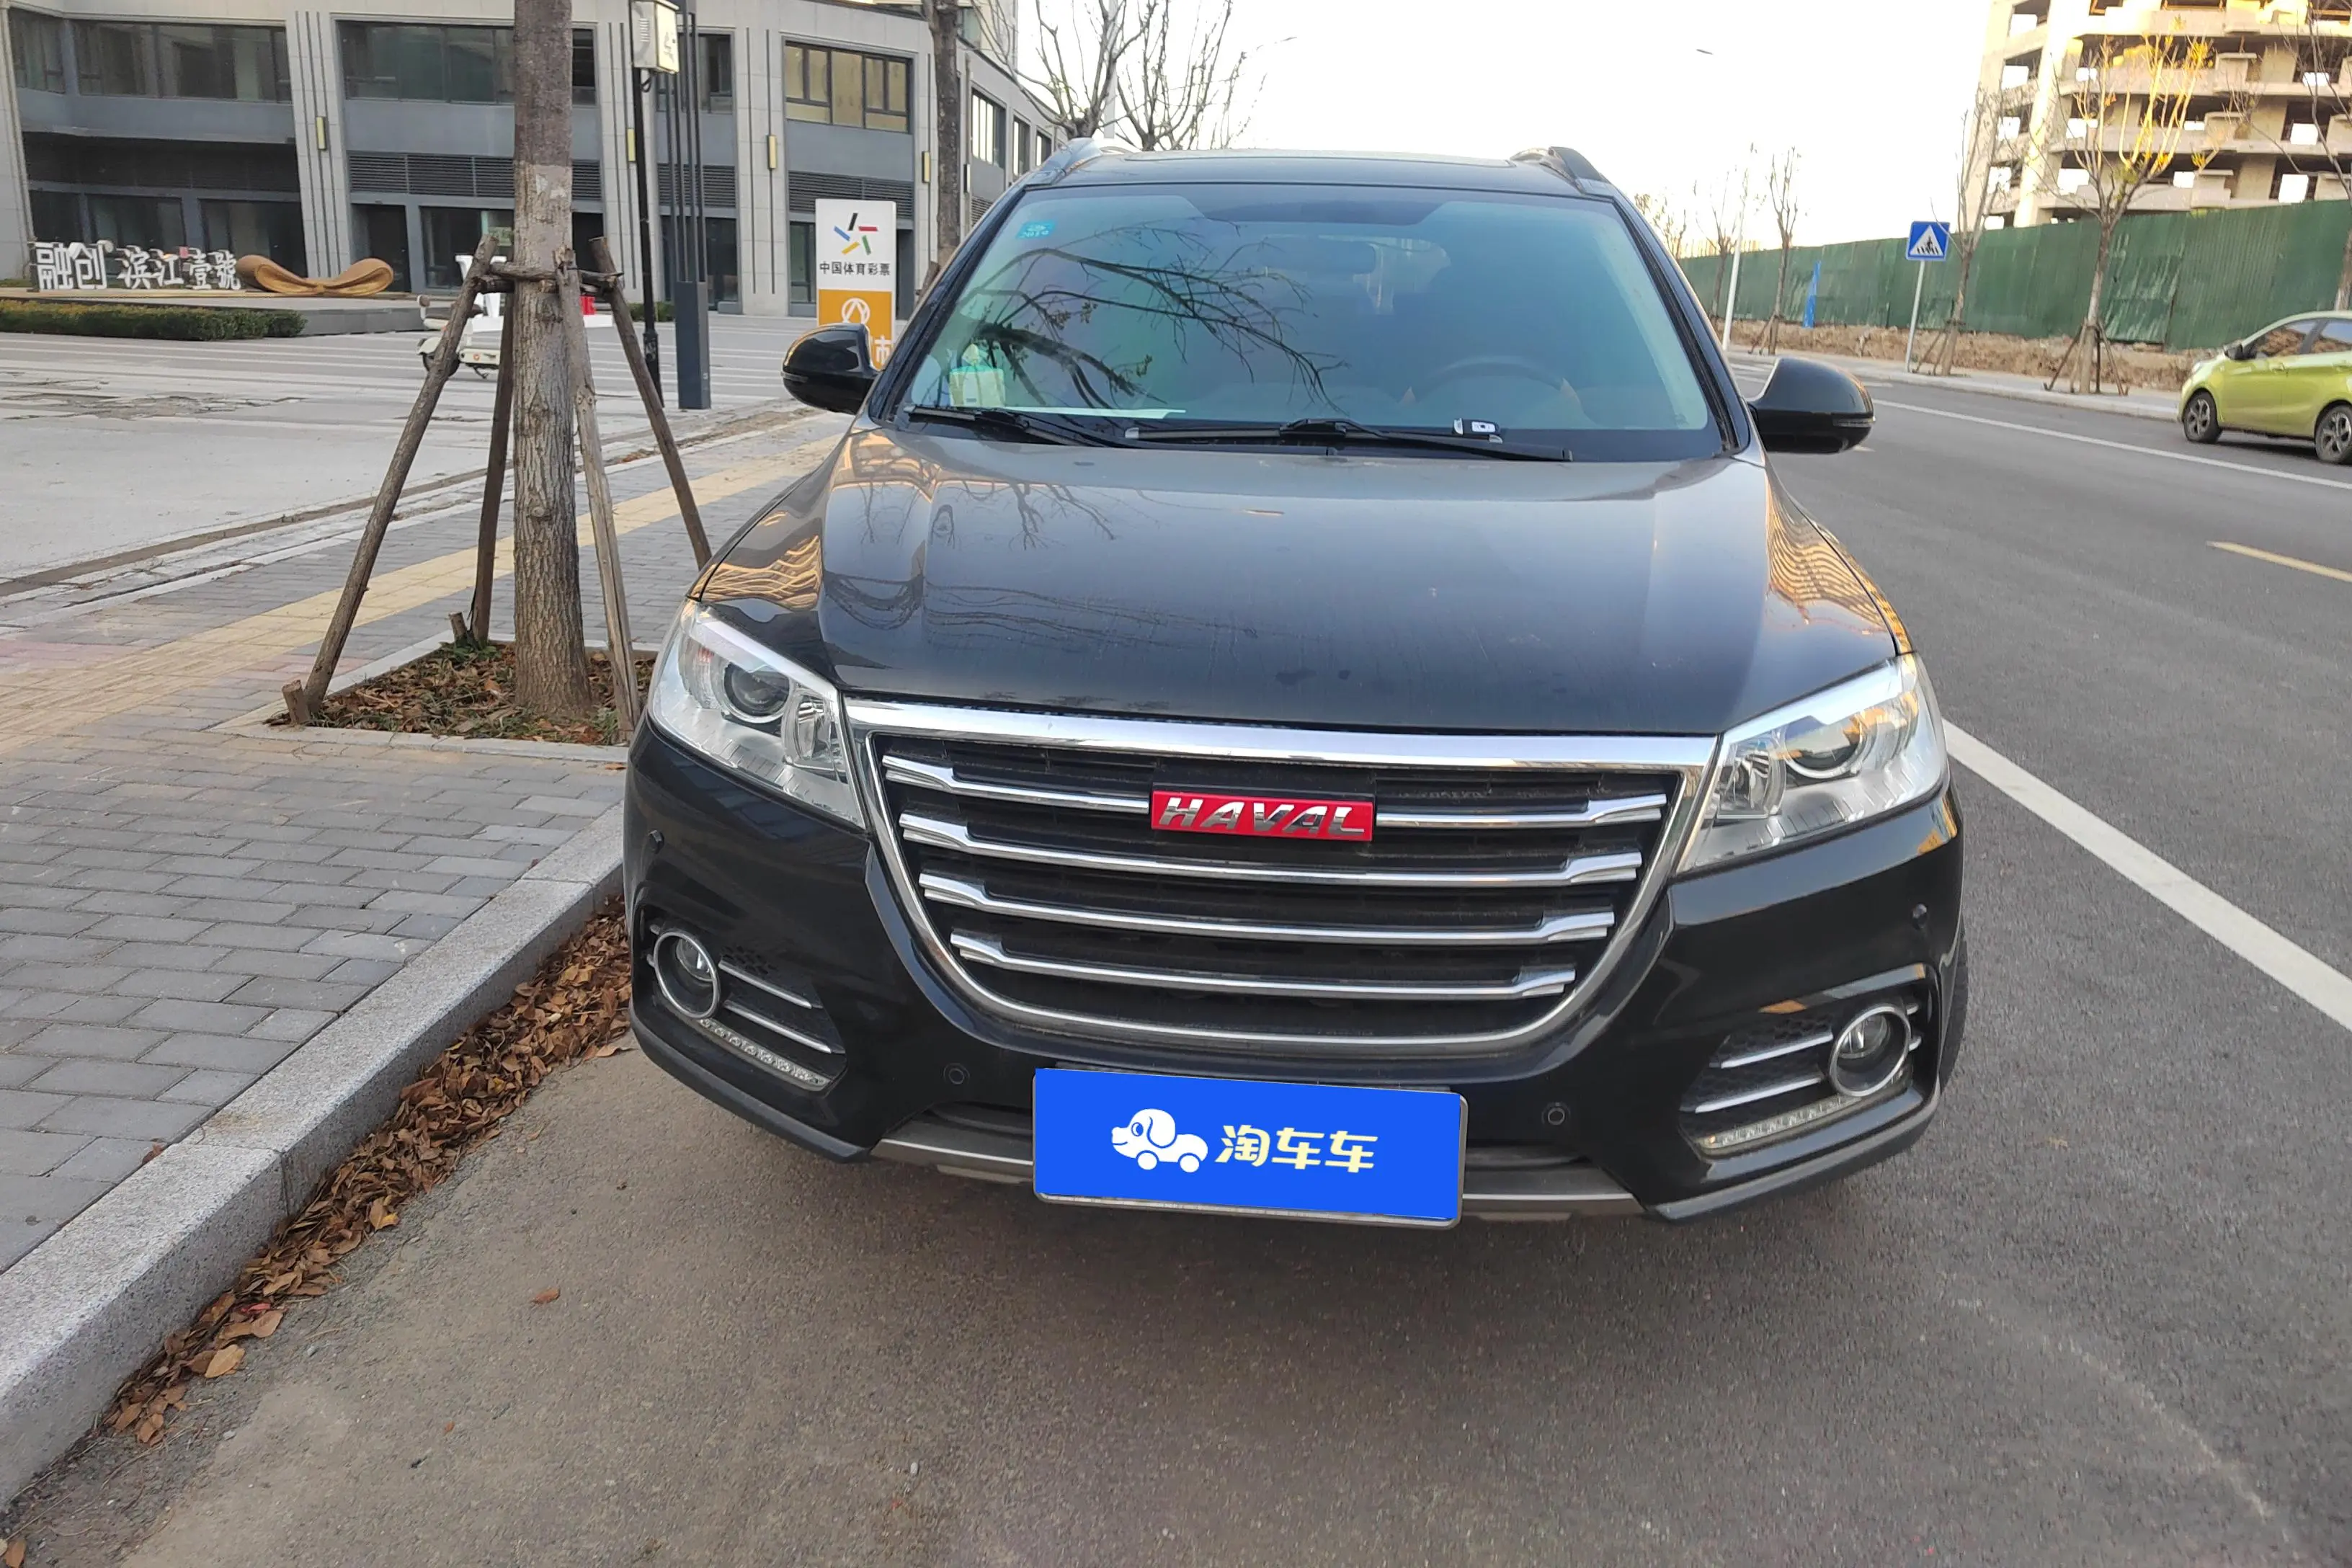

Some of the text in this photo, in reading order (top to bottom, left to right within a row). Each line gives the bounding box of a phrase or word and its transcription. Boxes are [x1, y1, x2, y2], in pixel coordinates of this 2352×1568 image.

[35, 241, 107, 289] 融创
[819, 261, 890, 275] 中国体育彩票
[870, 334, 892, 365] 市
[1159, 796, 1365, 836] HAVAL
